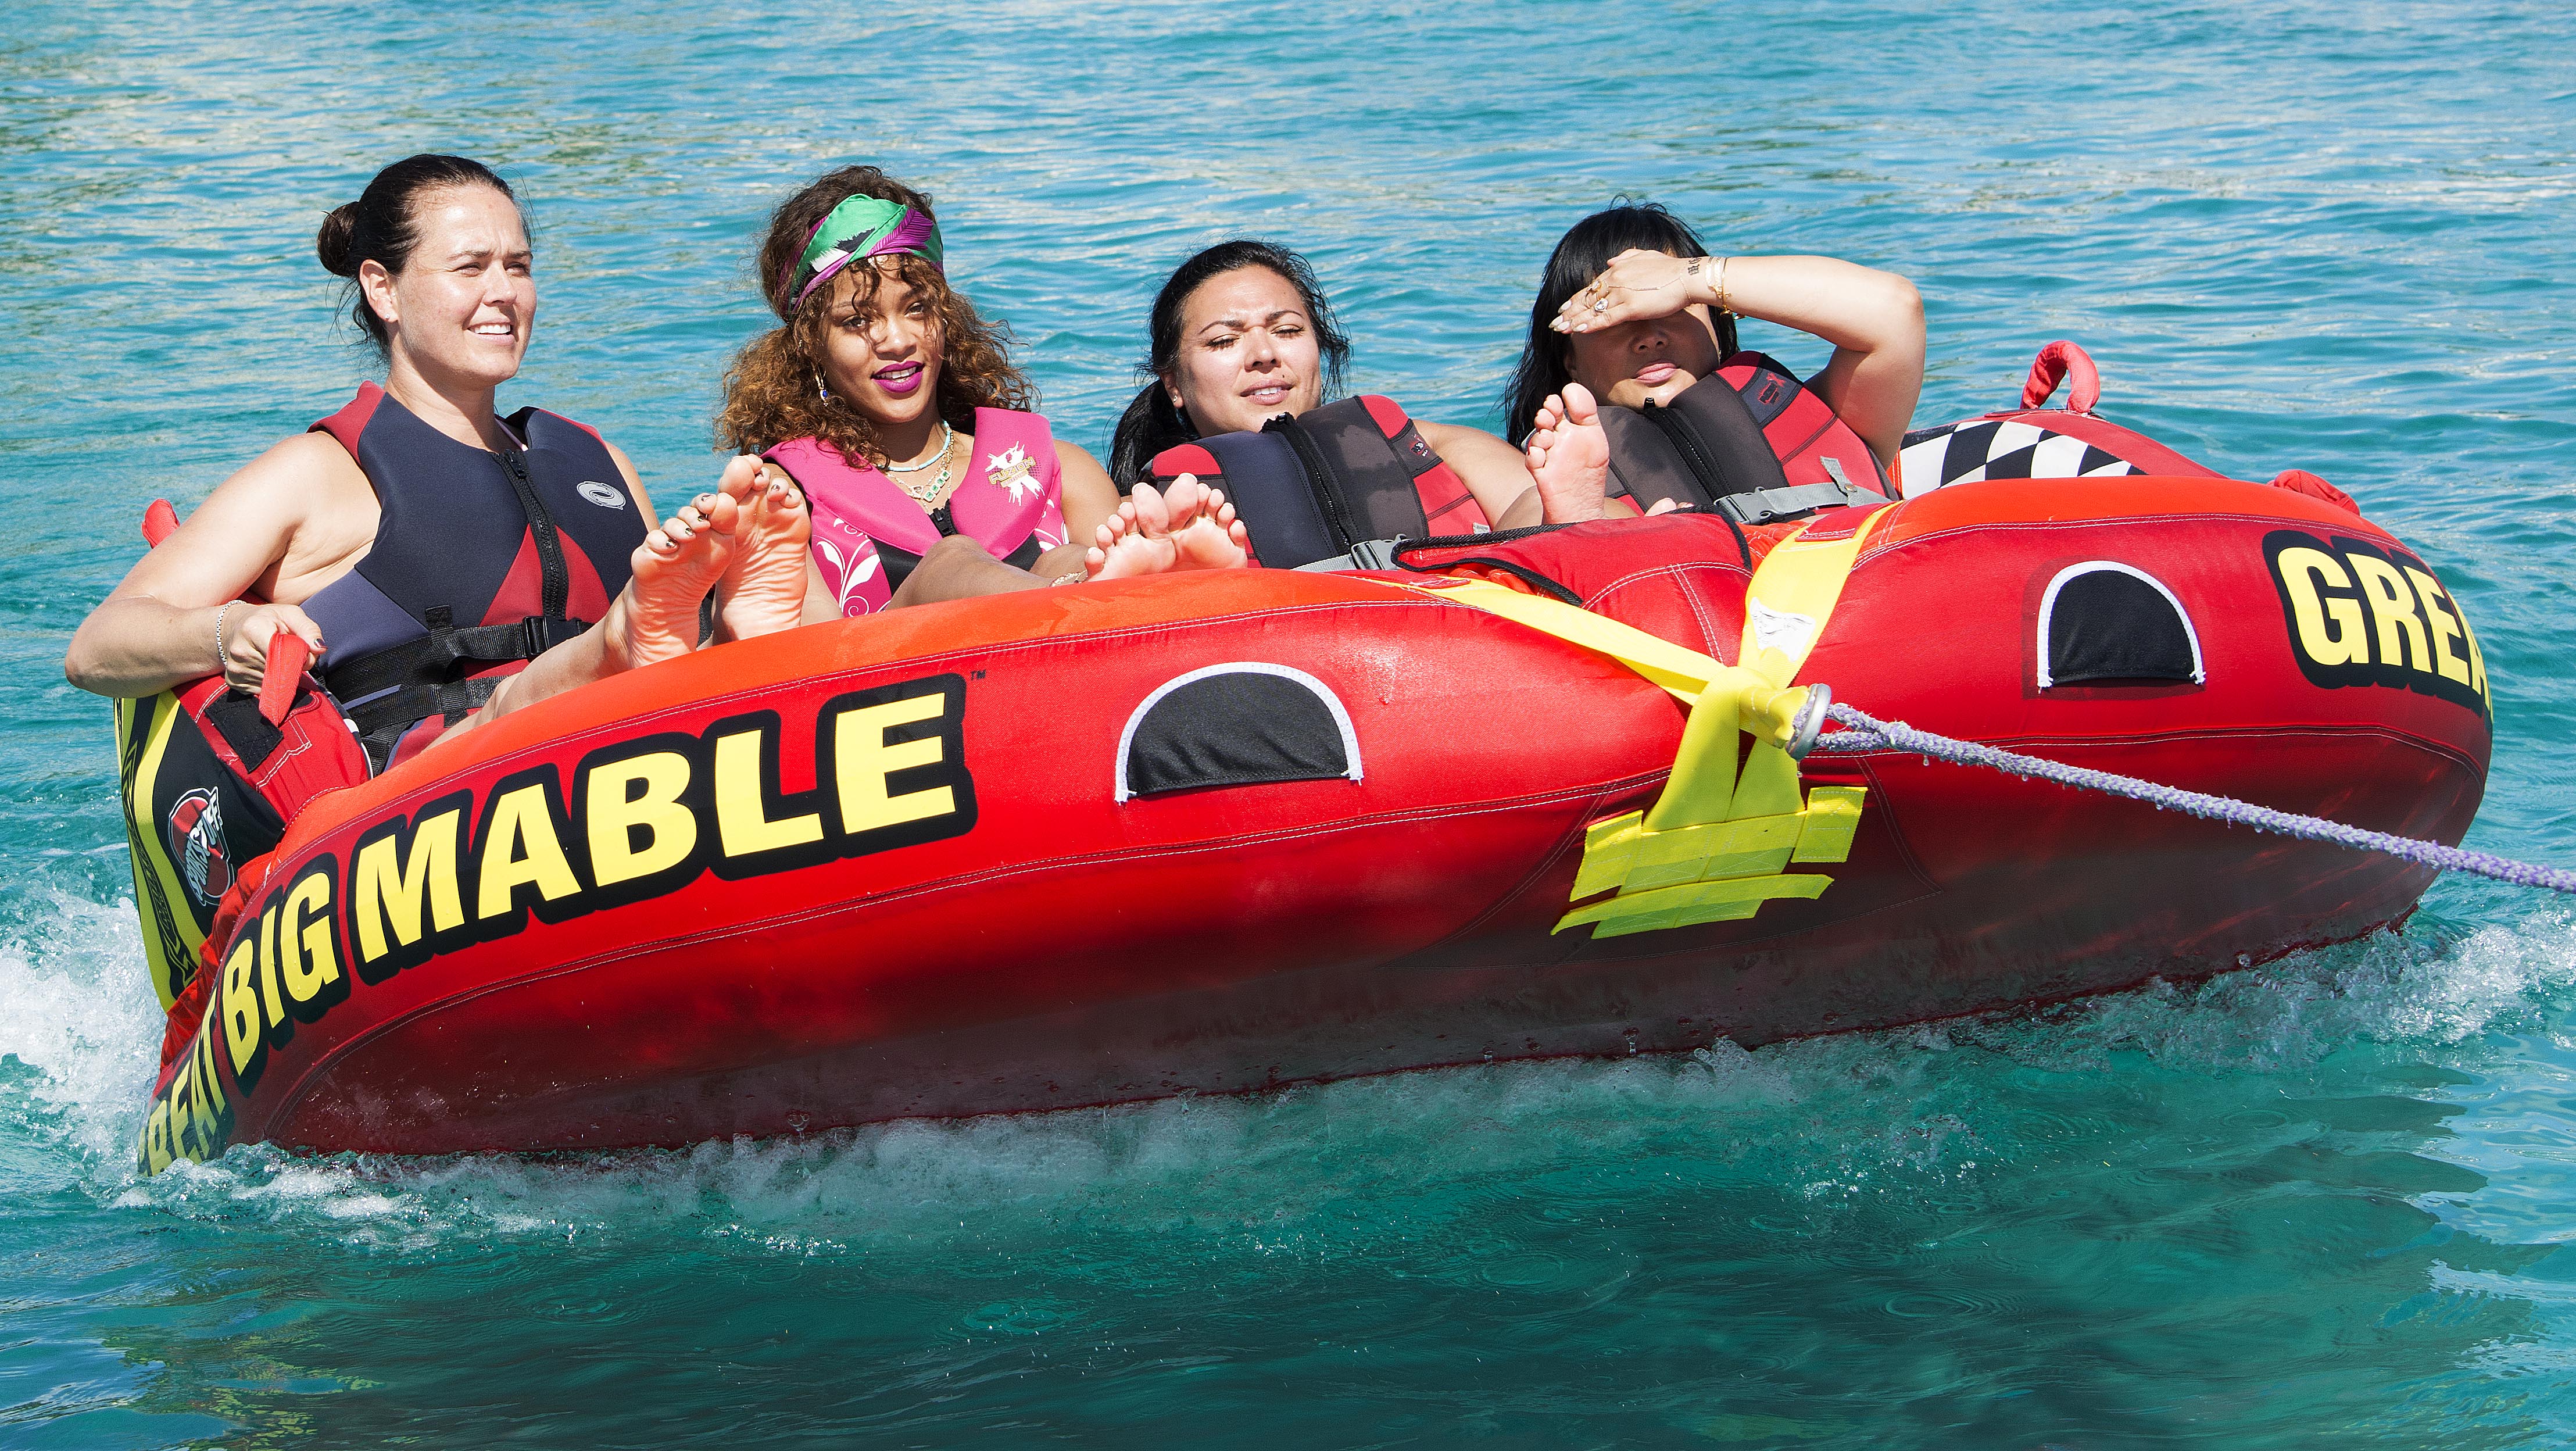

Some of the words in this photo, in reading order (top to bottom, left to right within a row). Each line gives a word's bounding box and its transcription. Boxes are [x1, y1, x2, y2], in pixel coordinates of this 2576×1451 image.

[989, 456, 1036, 484] FUZION
[2278, 547, 2493, 721] GREA
[138, 987, 226, 1176] REAT
[222, 873, 339, 1076] BIG
[356, 692, 956, 963] MABLE
